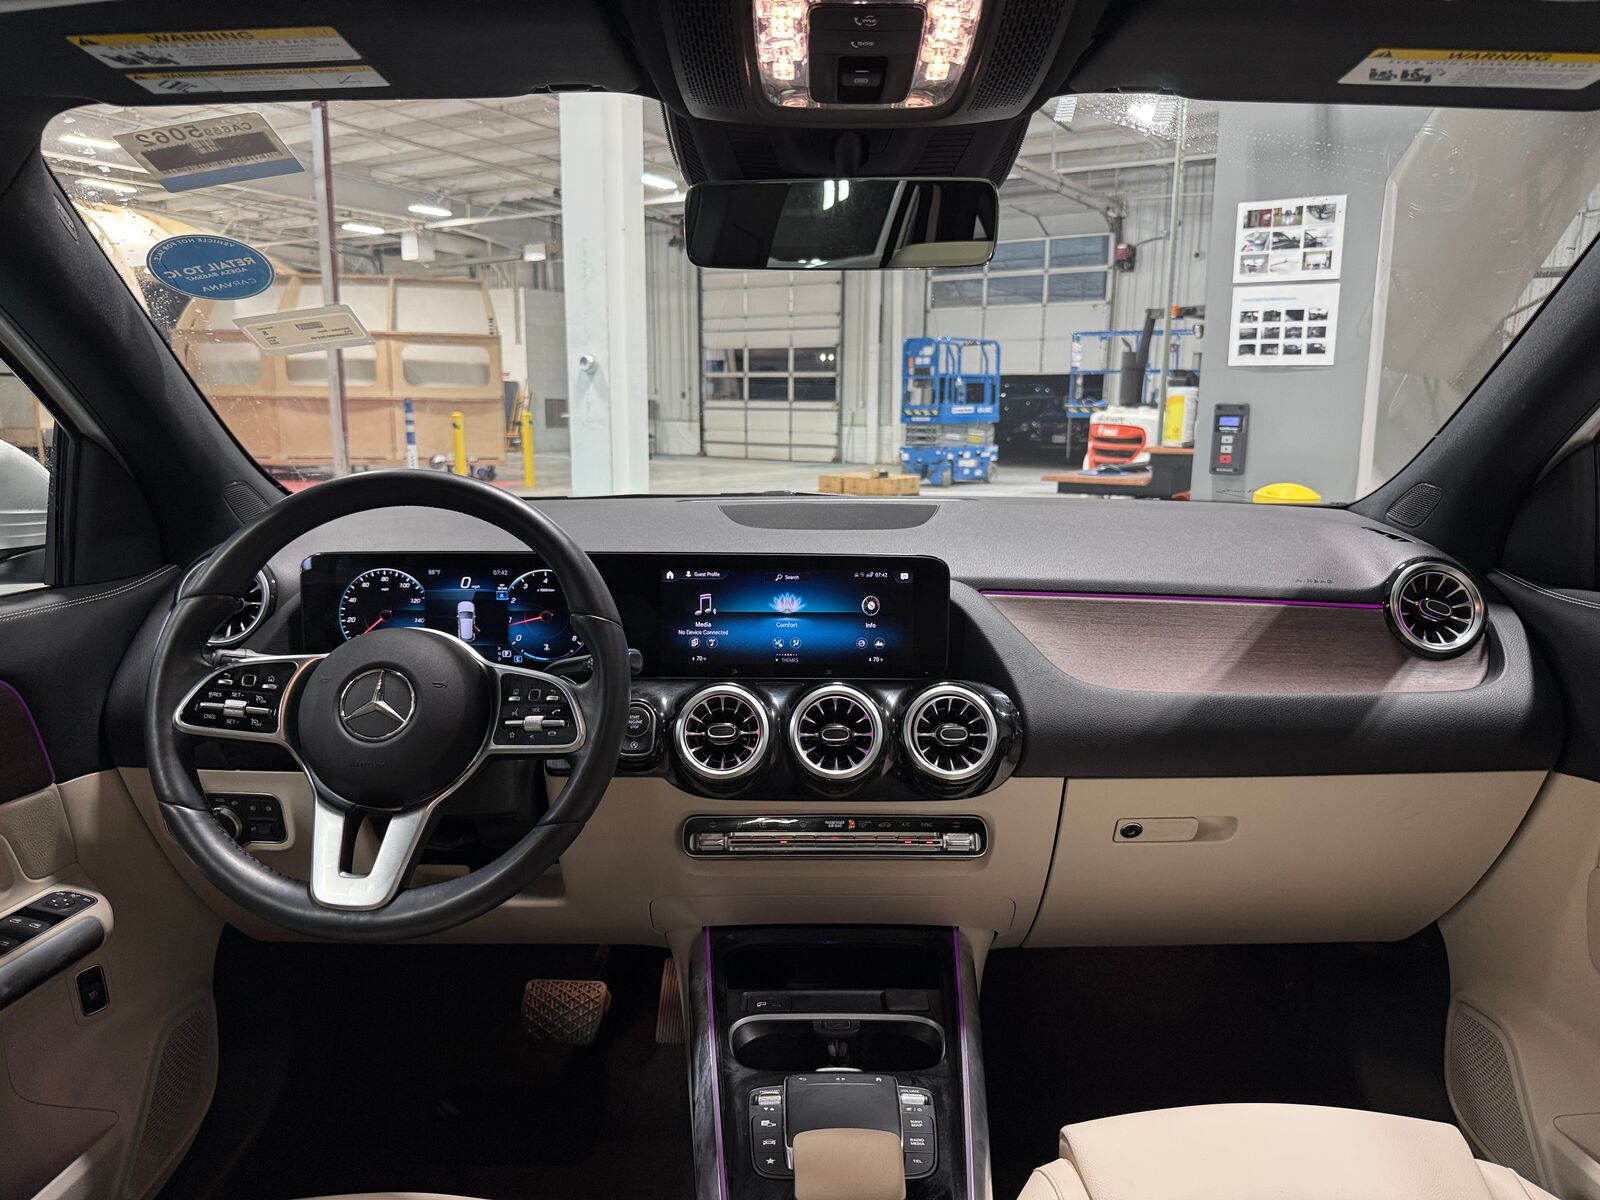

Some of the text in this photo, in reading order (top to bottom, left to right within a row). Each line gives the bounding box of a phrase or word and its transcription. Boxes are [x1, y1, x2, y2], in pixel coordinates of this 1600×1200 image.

[146, 31, 254, 42] WARNING
[1448, 52, 1552, 61] WARNING
[460, 576, 472, 589] 0
[515, 634, 522, 642] 0
